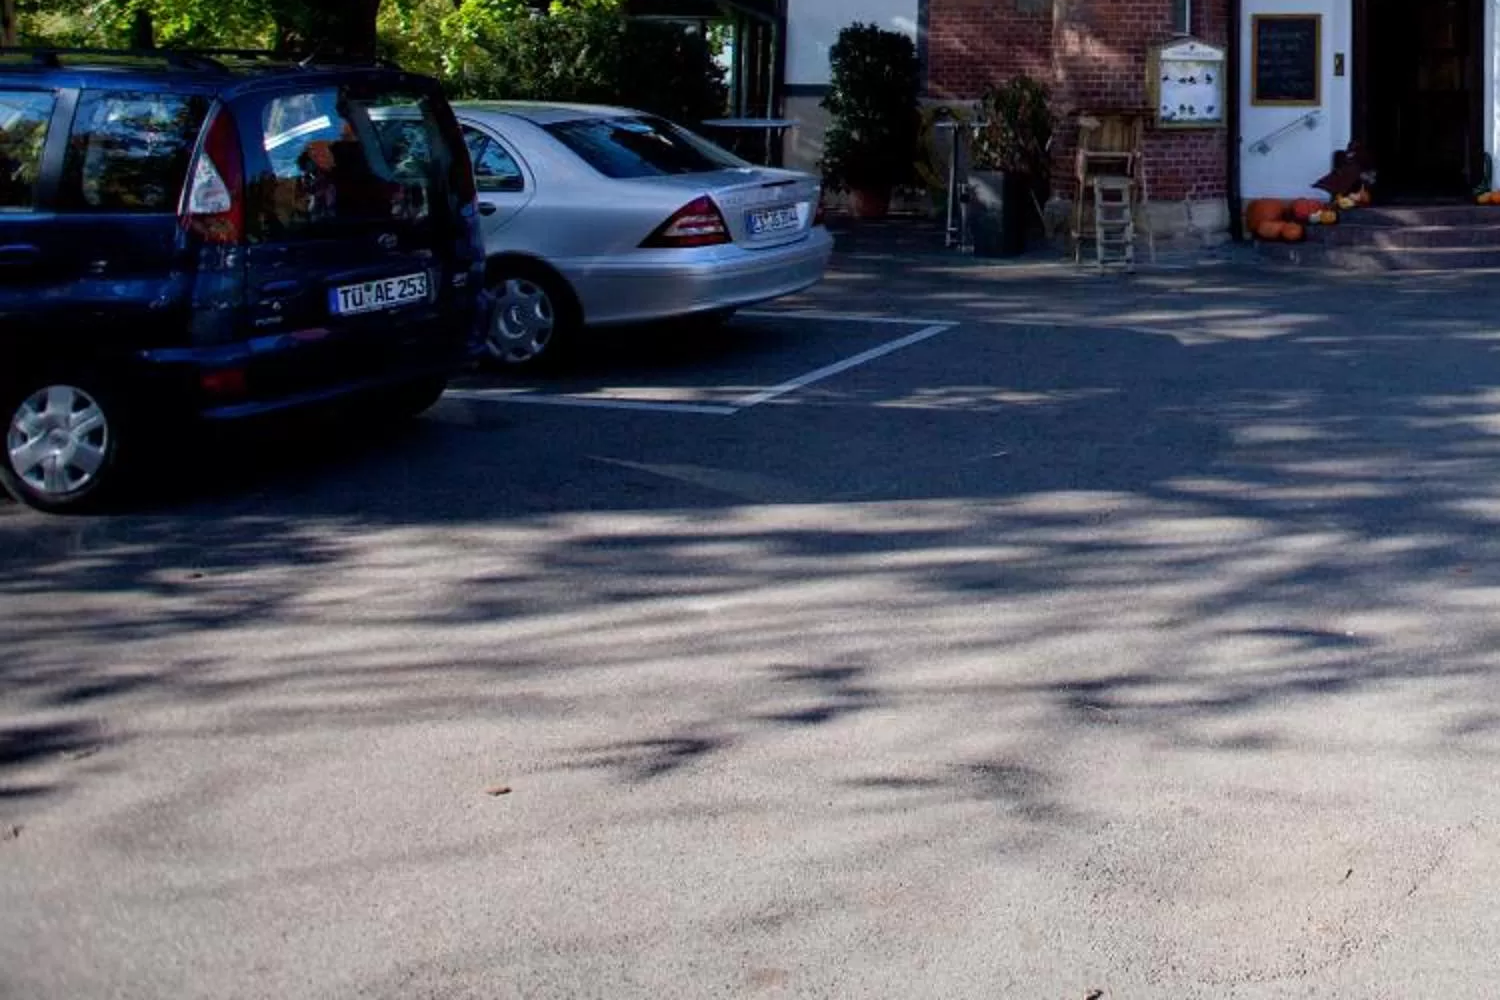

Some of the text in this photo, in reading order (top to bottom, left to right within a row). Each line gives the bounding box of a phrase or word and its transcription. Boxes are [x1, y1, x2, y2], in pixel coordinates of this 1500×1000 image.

[340, 286, 364, 309] TÜ
[375, 281, 395, 302] AE
[398, 275, 426, 298] 253
